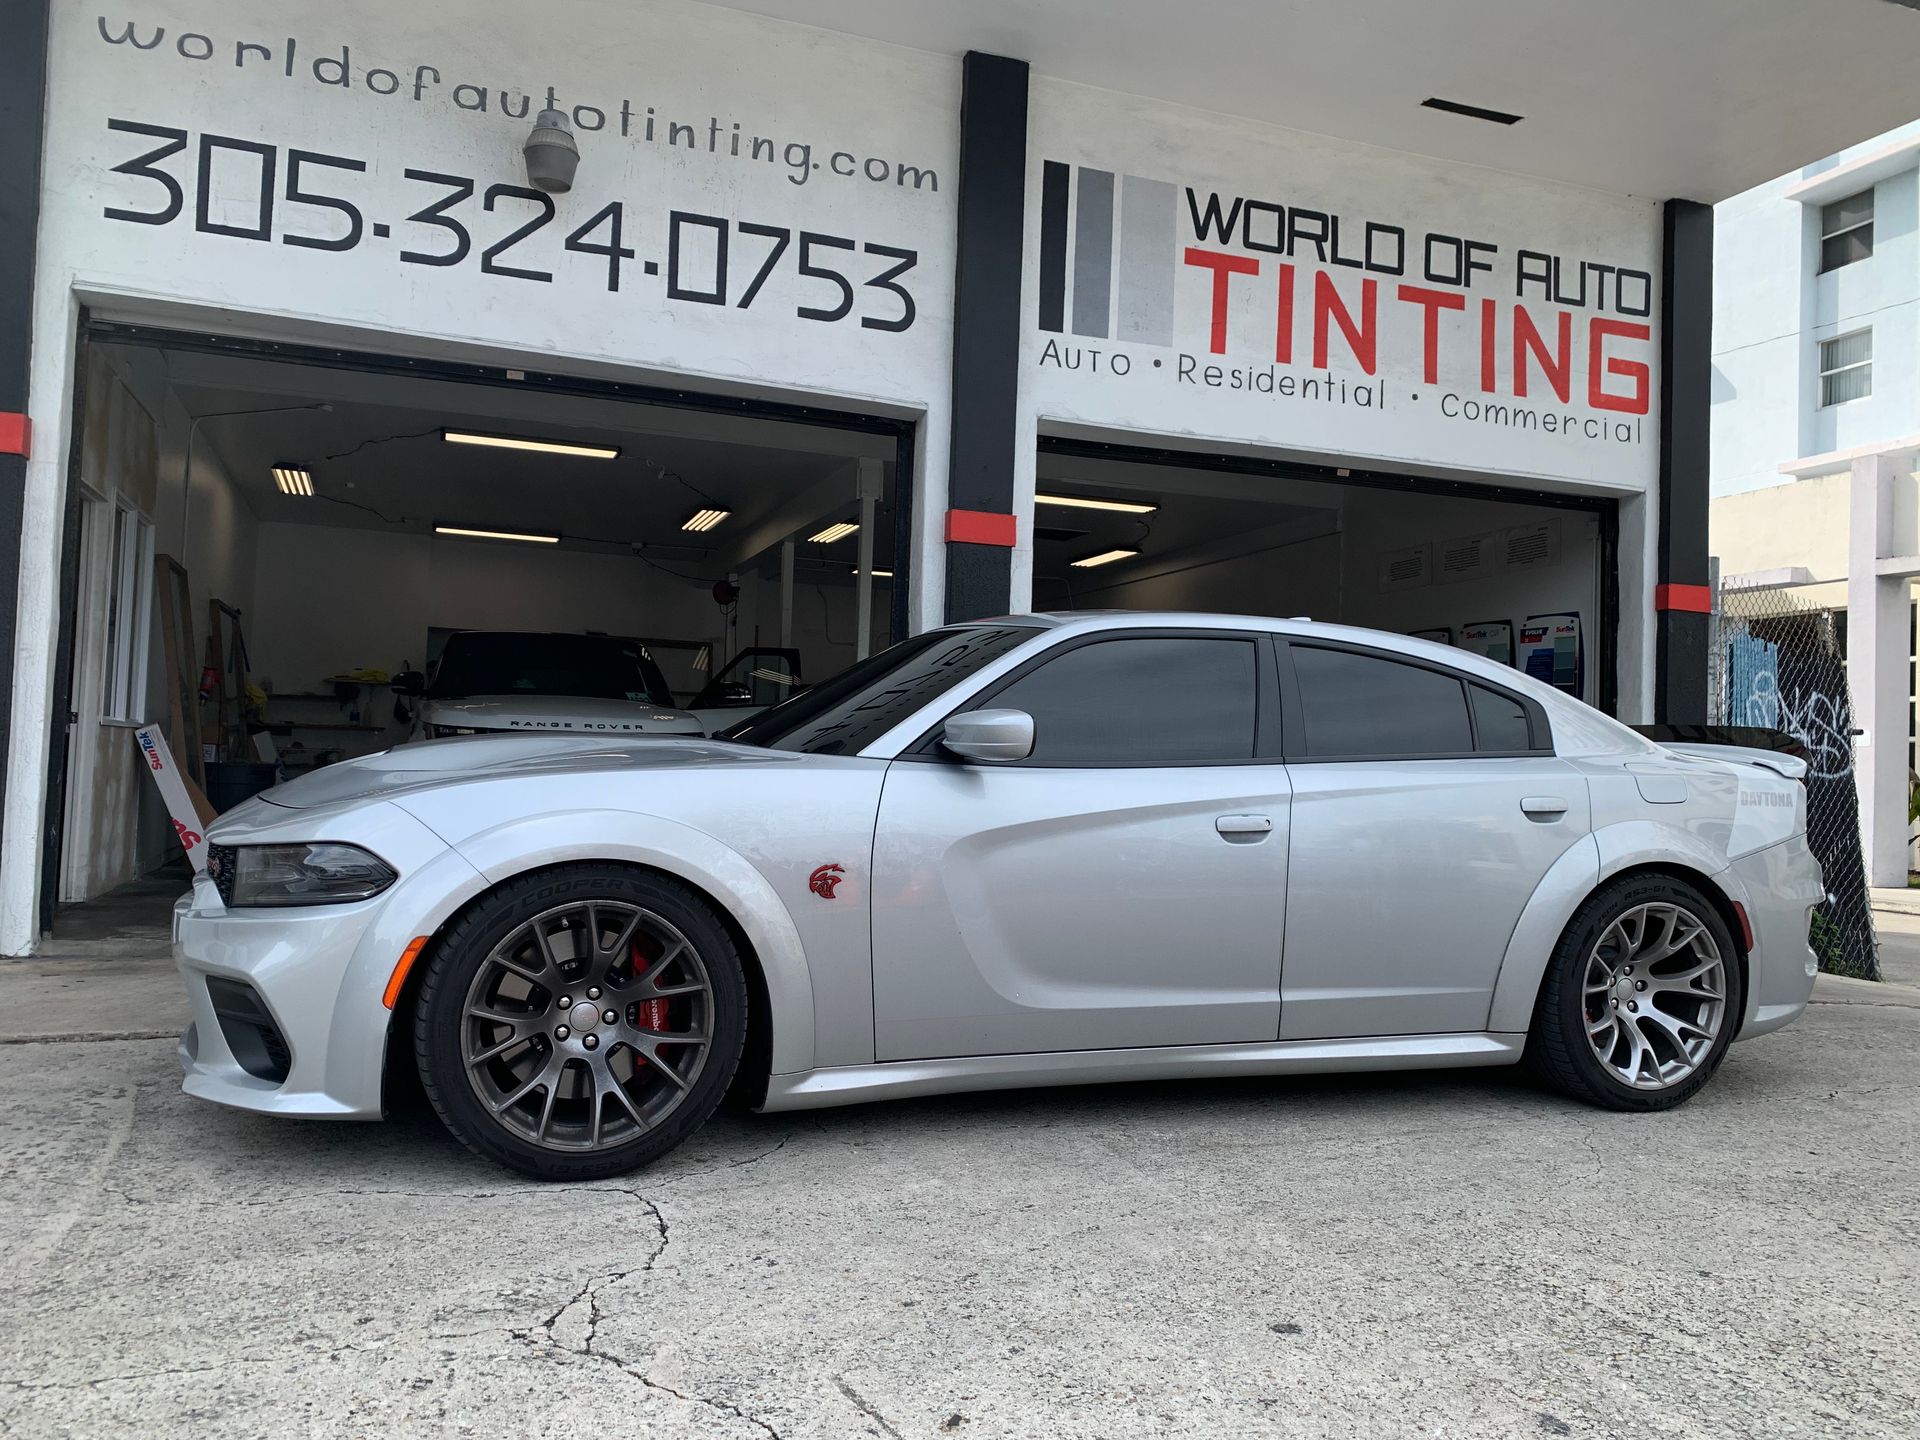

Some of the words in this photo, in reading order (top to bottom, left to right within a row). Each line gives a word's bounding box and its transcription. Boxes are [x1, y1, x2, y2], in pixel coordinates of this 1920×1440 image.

[98, 17, 938, 192] worldofautotinting.com
[105, 118, 917, 332] 305.324.0753
[1186, 187, 1405, 277] WORLD
[1425, 233, 1498, 289] OF
[1517, 250, 1652, 318] AUTO
[1185, 248, 1650, 415] TINTING
[1178, 353, 1385, 410] Residential
[1441, 393, 1641, 444] Commercial
[1466, 630, 1488, 639] SunTek
[138, 731, 163, 771] SunTek
[510, 720, 572, 728] RANGE
[1740, 791, 1793, 808] DAYTONA
[521, 878, 624, 908] COOPER
